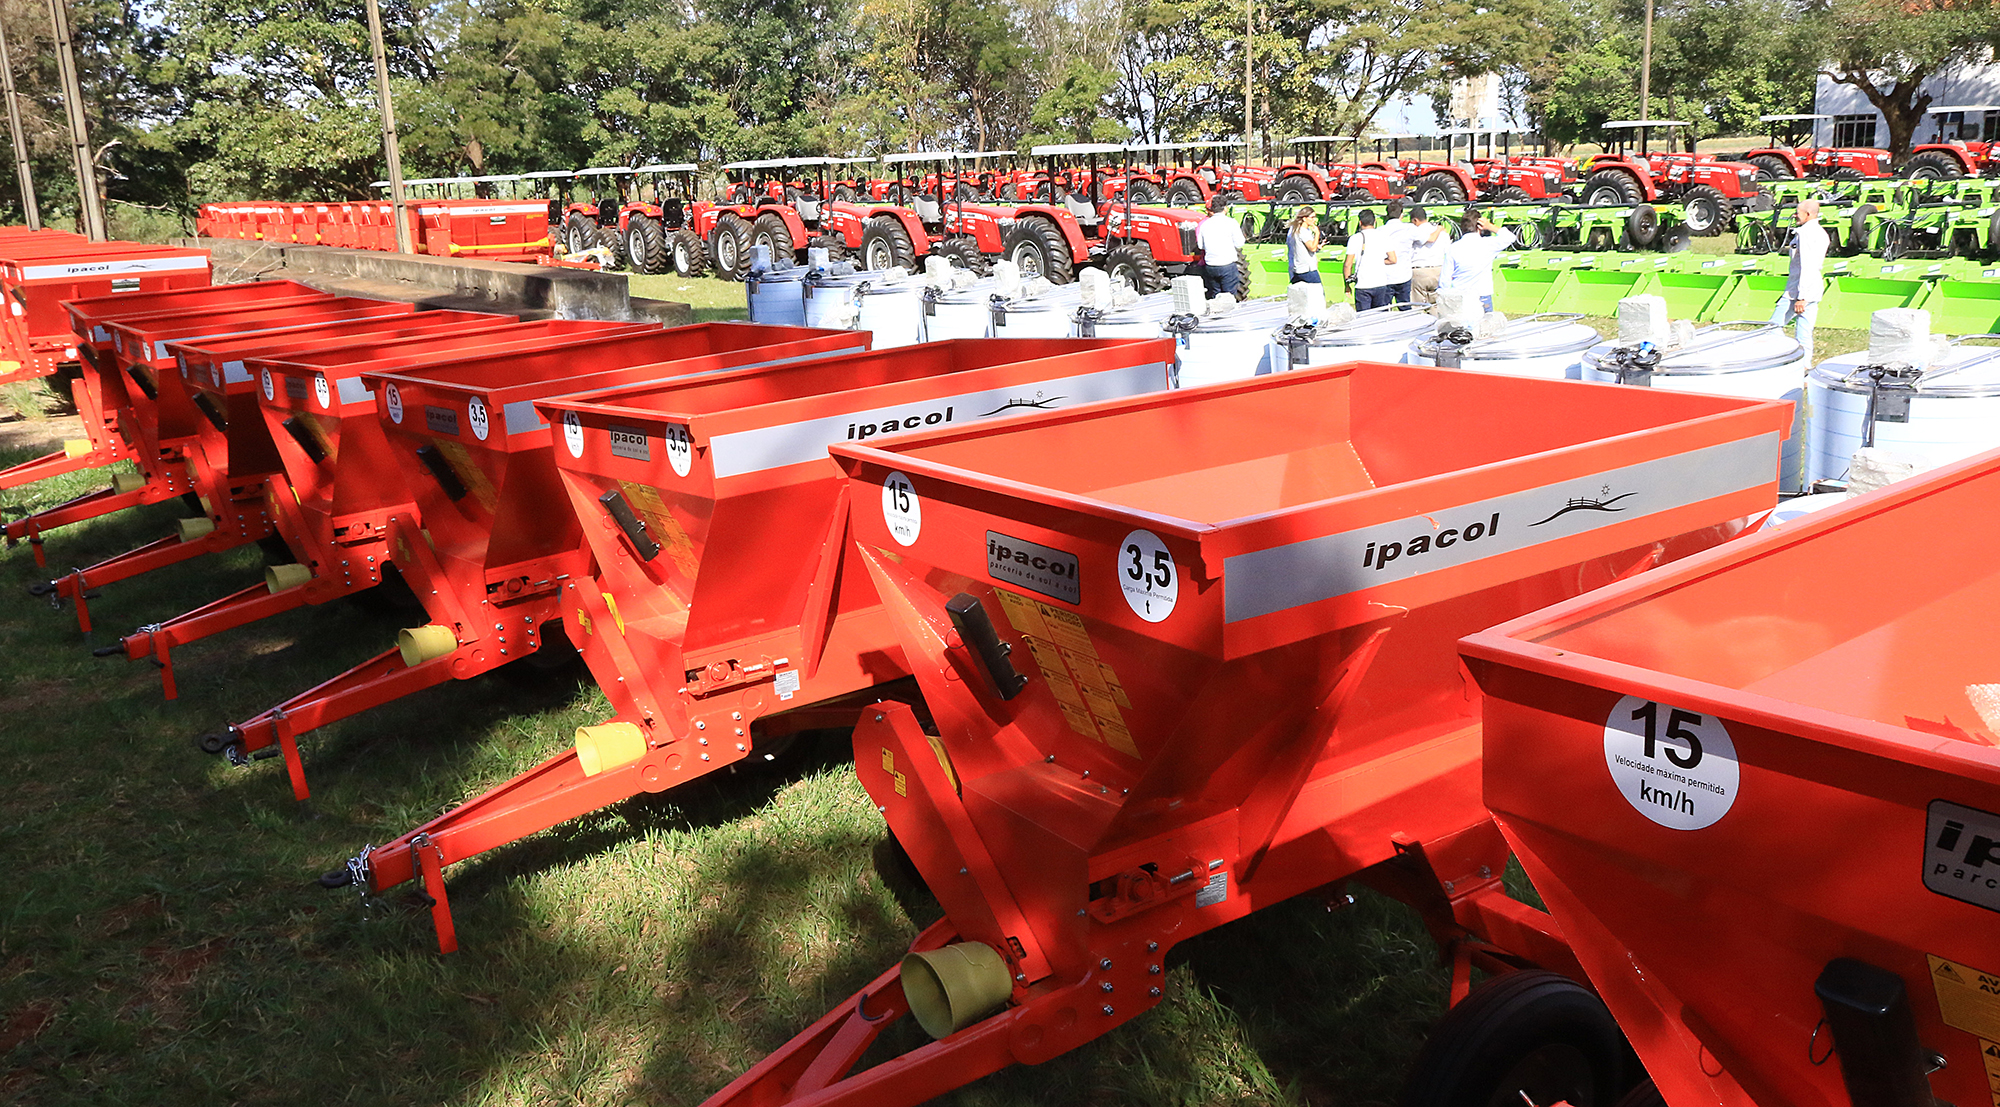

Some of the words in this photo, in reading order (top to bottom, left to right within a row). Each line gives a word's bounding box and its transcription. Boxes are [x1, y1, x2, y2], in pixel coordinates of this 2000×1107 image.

[67, 264, 110, 273] ipacol
[388, 388, 398, 406] 15
[426, 409, 457, 423] ipacol
[471, 404, 486, 426] 3,5
[566, 412, 578, 435] 15
[847, 407, 954, 440] ipacol
[610, 430, 647, 446] ipacol
[668, 427, 688, 457] 3,5
[888, 479, 910, 514] 15
[1363, 512, 1500, 570] ipacol
[989, 539, 1076, 580] ipacol
[1126, 543, 1171, 592] 3,5
[990, 561, 1022, 576] parceria
[1026, 572, 1035, 581] de
[1039, 577, 1052, 586] sol
[1063, 585, 1077, 593] sol
[1145, 599, 1151, 615] t
[1631, 700, 1703, 770] 15
[1614, 754, 1655, 775] Velocidade
[1656, 768, 1686, 784] máxima
[1687, 777, 1725, 796] permitida
[1640, 778, 1695, 816] km/h
